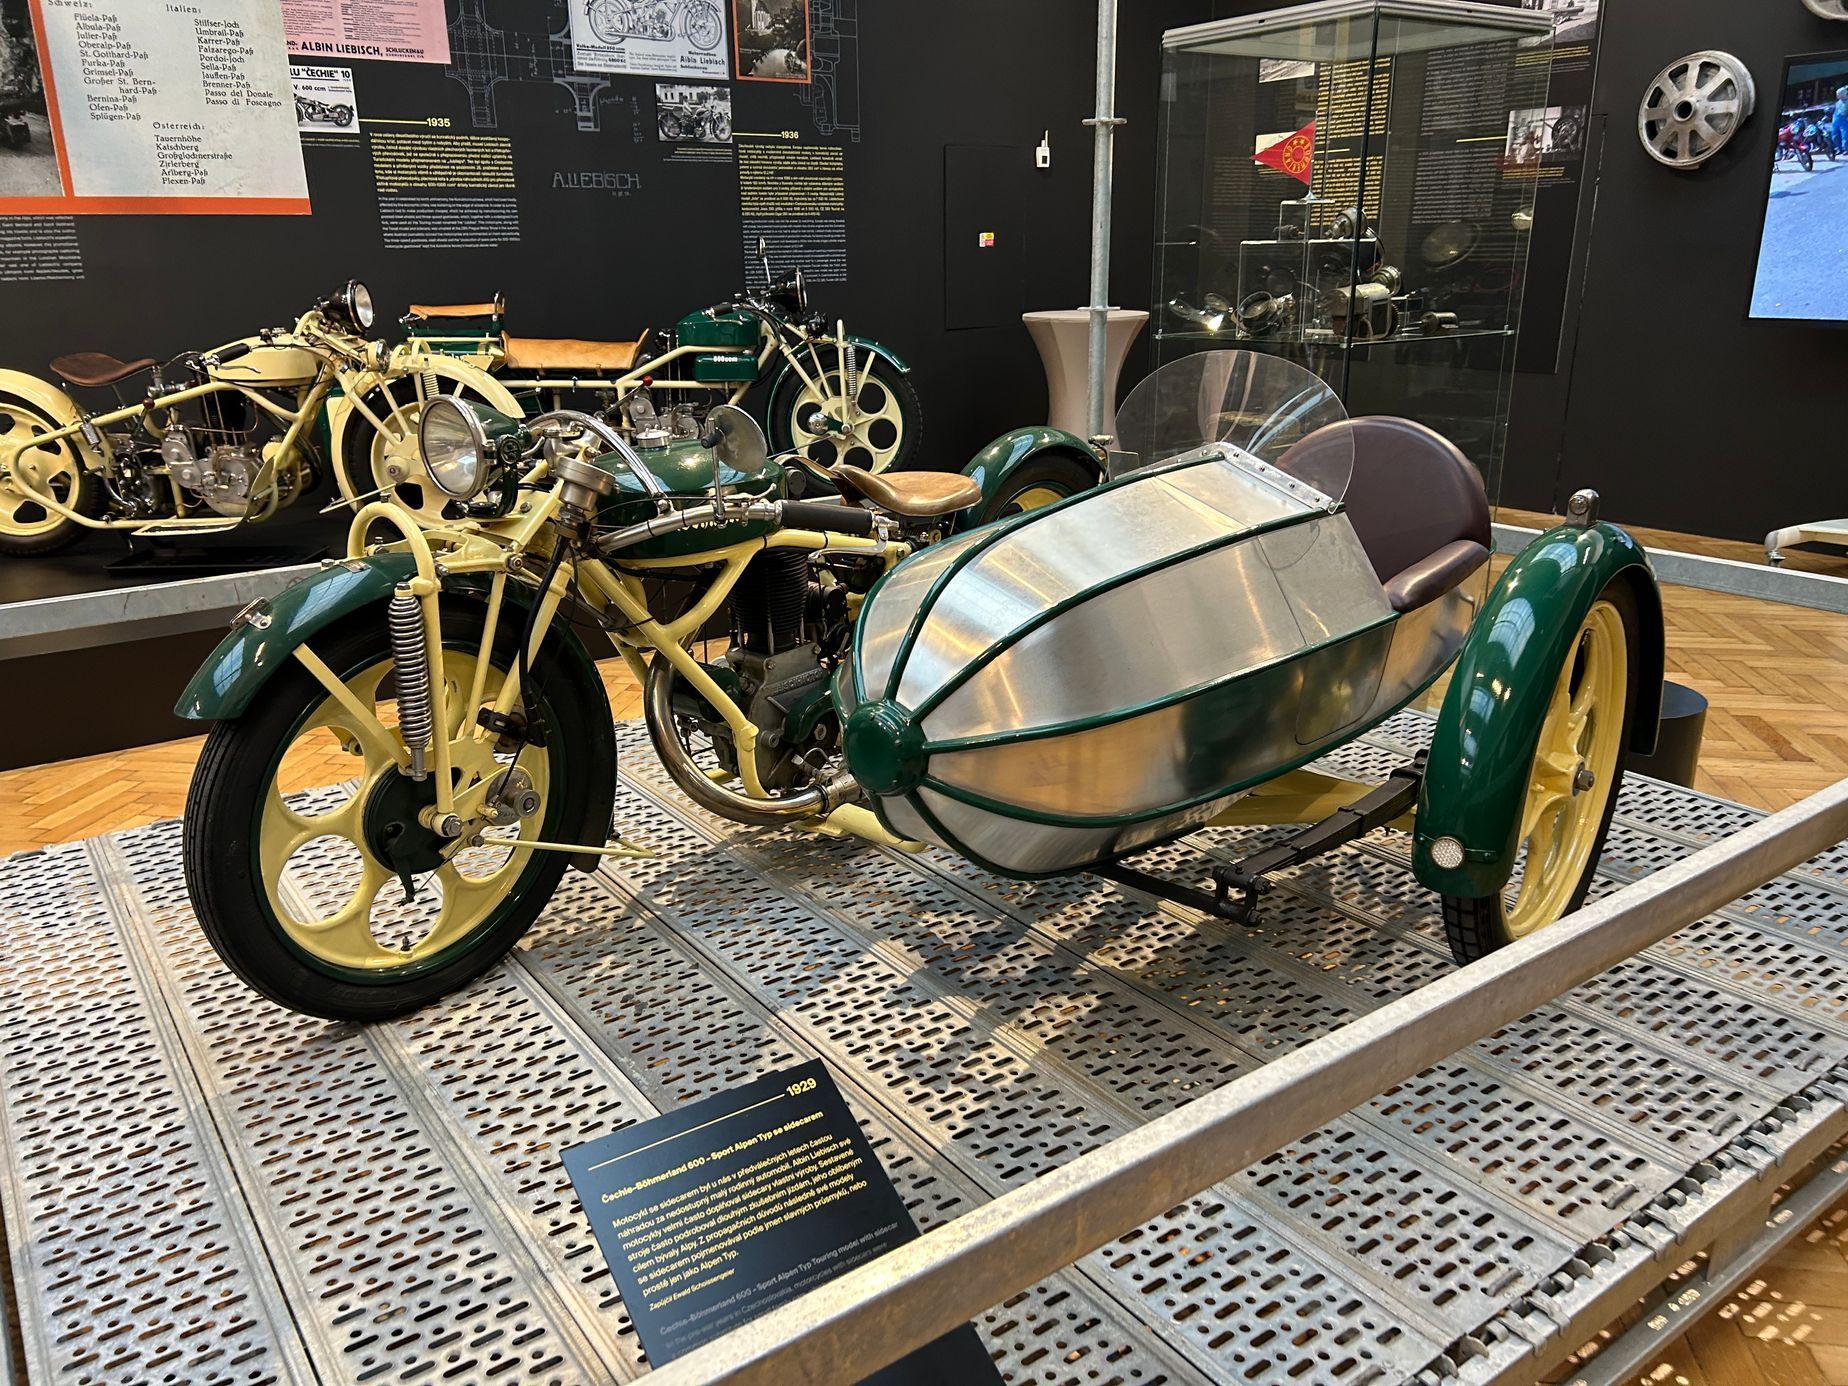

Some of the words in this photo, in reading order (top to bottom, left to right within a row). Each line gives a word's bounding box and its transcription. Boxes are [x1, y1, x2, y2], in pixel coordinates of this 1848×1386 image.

[166, 4, 201, 14] Italien:
[301, 41, 333, 53] ALBIN
[336, 44, 383, 56] LIEBISCH,
[341, 70, 350, 78] 10
[205, 88, 227, 97] Passo
[230, 89, 243, 97] del
[206, 97, 228, 106] Passo
[232, 98, 240, 106] di
[246, 98, 282, 108] Foscagno
[426, 118, 451, 128] 1935
[781, 131, 799, 139] 1936
[154, 135, 202, 143] Tauernhöhe
[785, 1077, 816, 1096] 1929
[687, 1156, 705, 1169] 600
[710, 1145, 734, 1160] Sport
[734, 1136, 758, 1151] Alpen
[756, 1131, 773, 1143] Typ
[772, 1127, 783, 1136] se
[782, 1111, 824, 1132] sidecarem
[612, 1207, 648, 1228] Motocykl
[648, 1204, 659, 1213] se
[659, 1188, 699, 1209] sidecarem
[698, 1182, 711, 1193] byl
[717, 1175, 731, 1185] nás
[736, 1152, 788, 1178] předválečných
[786, 1143, 809, 1157] letech
[809, 1133, 833, 1148] častou
[617, 1219, 655, 1239] náhradou
[655, 1211, 665, 1224] za
[665, 1195, 709, 1219] nedostupný
[709, 1187, 727, 1201] malý
[727, 1176, 755, 1193] rodinný
[755, 1161, 792, 1182] automobil.
[792, 1154, 810, 1167] Albin
[809, 1142, 839, 1160] Liebisch
[838, 1137, 851, 1148] své
[622, 1228, 661, 1250] motocykly
[662, 1218, 683, 1233] velmi
[683, 1211, 705, 1225] často
[705, 1194, 741, 1215] doplňoval
[741, 1183, 772, 1200] sidecary
[771, 1172, 795, 1187] vlastní
[817, 1148, 854, 1168] Sestavené
[627, 1247, 650, 1261] stroje
[650, 1237, 673, 1251] často
[673, 1217, 716, 1244] podroboval
[716, 1205, 748, 1224] dlouhým
[748, 1189, 787, 1210] zkušebním
[810, 1172, 828, 1185] jeho
[827, 1157, 862, 1176] oblíbeným
[637, 1275, 648, 1284] se
[648, 1256, 690, 1279] sidecarem
[690, 1232, 742, 1263] pojmenovával
[742, 1224, 764, 1240] podle
[763, 1216, 783, 1231] jmen
[782, 1202, 814, 1221] slavných
[848, 1180, 867, 1192] nebo
[654, 1248, 679, 1263] bývaly
[697, 1235, 705, 1245] Z
[705, 1215, 756, 1243] propagačních
[815, 1183, 829, 1194] své
[828, 1173, 854, 1189] modely
[642, 1278, 669, 1298] prostě
[668, 1273, 682, 1286] jen
[681, 1266, 699, 1280] jako
[700, 1256, 723, 1271] Alpen
[721, 1249, 739, 1261] Typ.
[776, 1266, 799, 1282] Alpen
[797, 1260, 812, 1272] Typ
[810, 1249, 839, 1266] Touring
[836, 1239, 860, 1254] model
